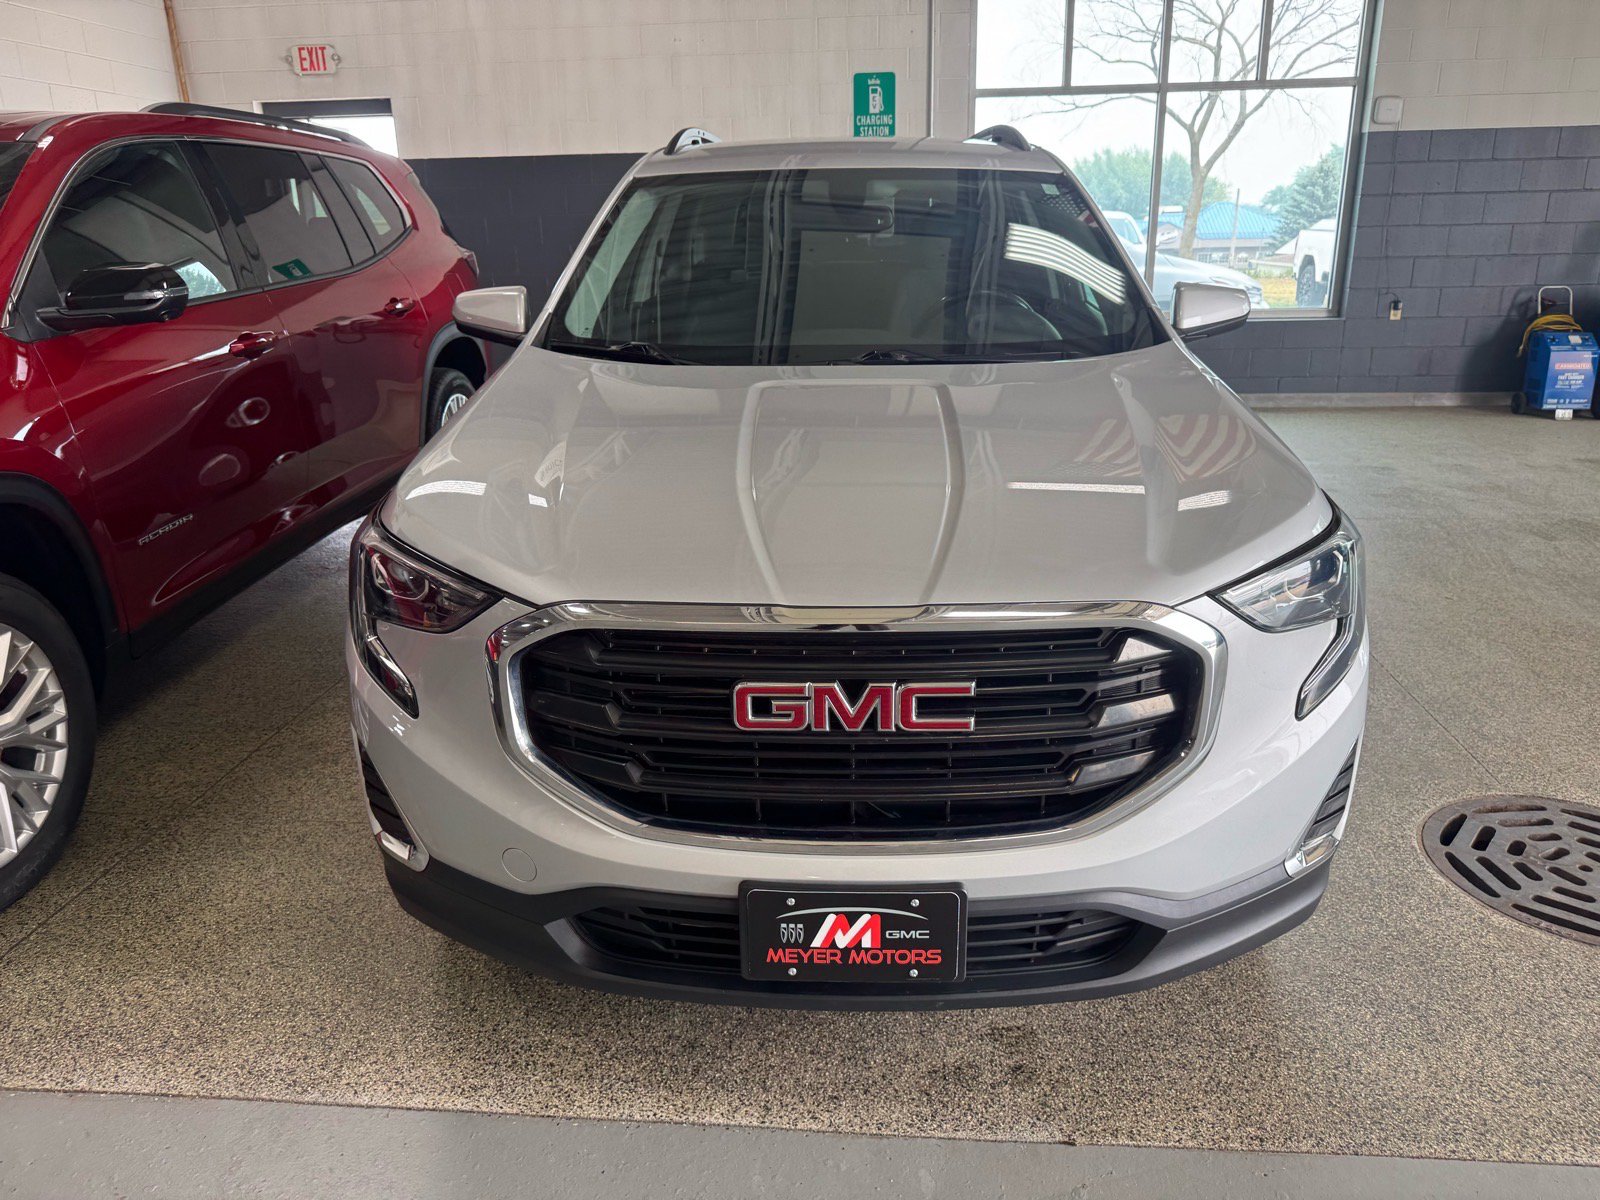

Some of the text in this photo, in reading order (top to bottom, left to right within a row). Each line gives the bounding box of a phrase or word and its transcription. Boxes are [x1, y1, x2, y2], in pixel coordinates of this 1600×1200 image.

[297, 46, 327, 71] EXIT
[856, 115, 893, 126] CHARGING
[860, 126, 890, 137] STATION
[139, 513, 193, 546] ACADIA
[733, 680, 976, 732] GMC
[885, 930, 930, 939] GMC
[766, 948, 942, 965] MEYER MOTORS
